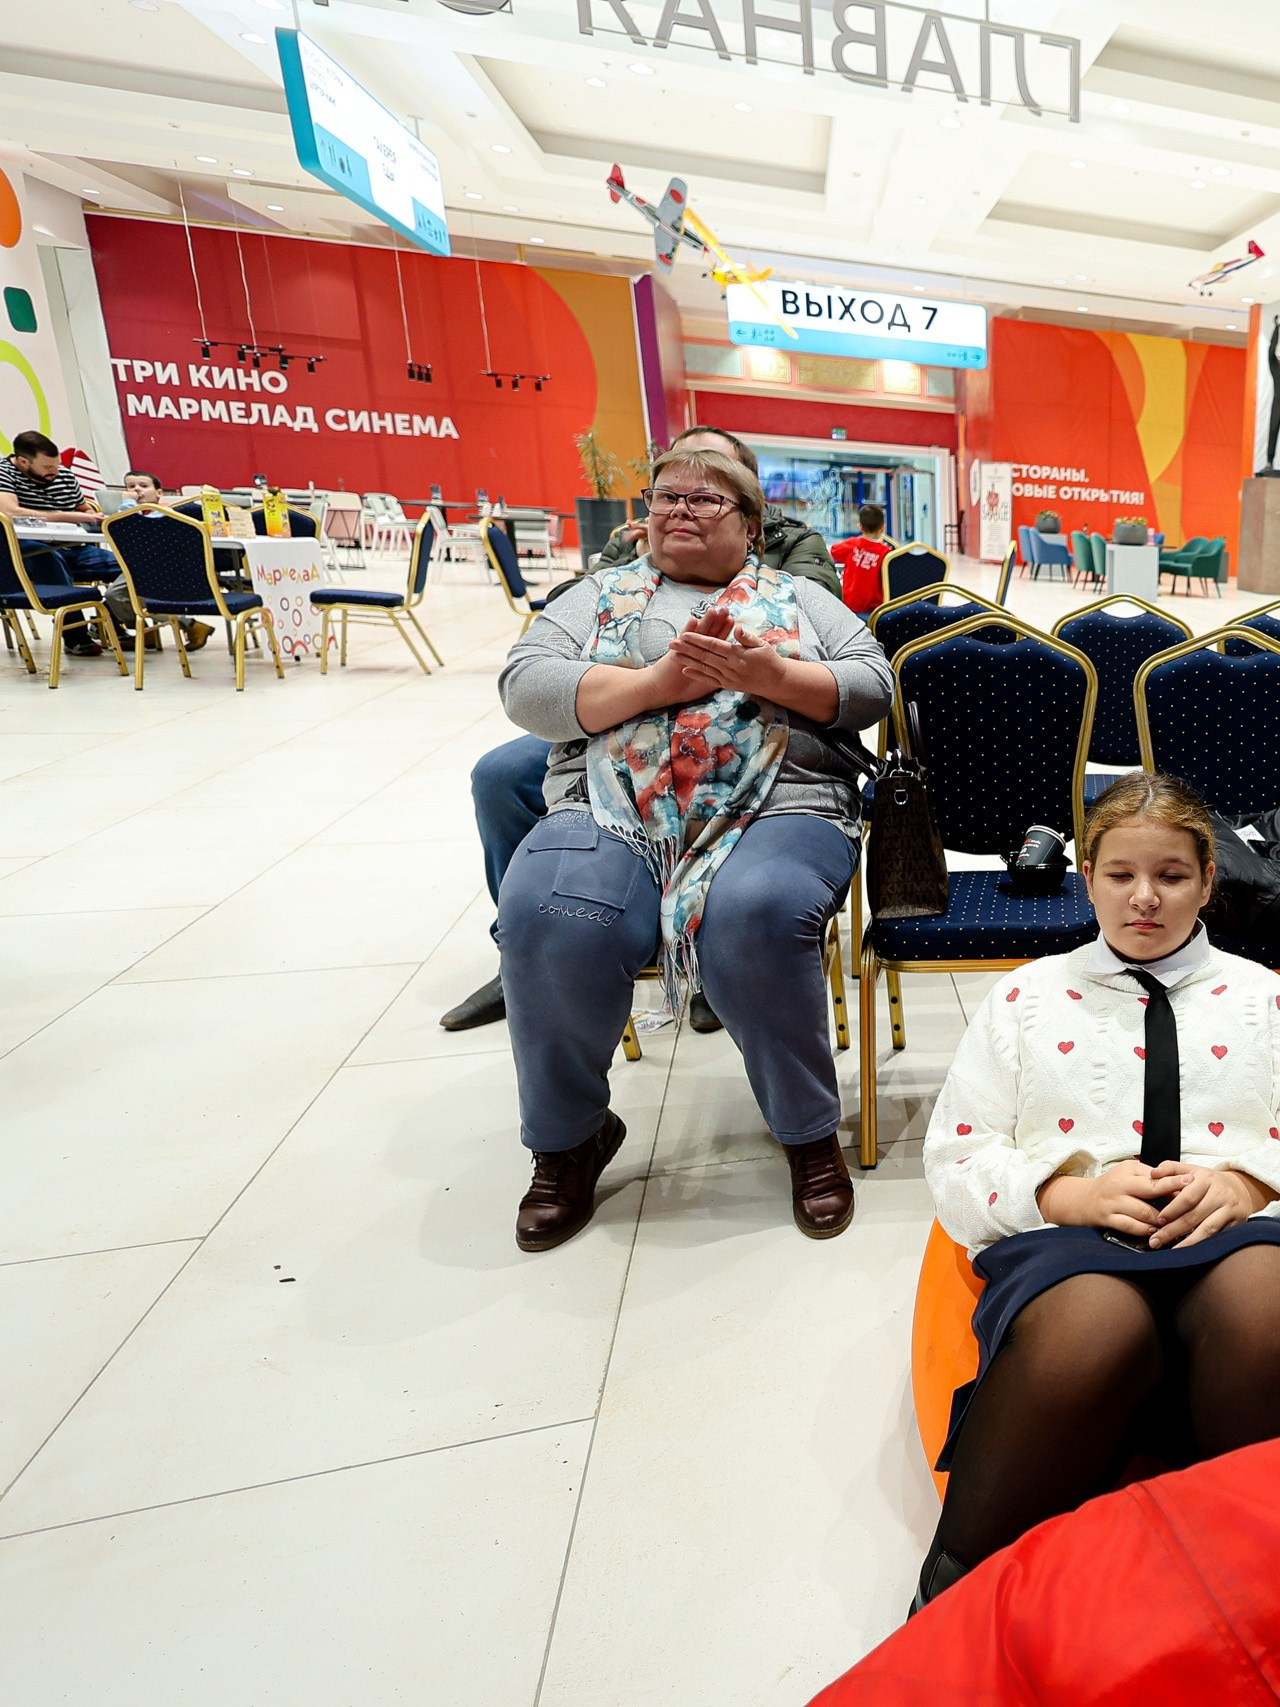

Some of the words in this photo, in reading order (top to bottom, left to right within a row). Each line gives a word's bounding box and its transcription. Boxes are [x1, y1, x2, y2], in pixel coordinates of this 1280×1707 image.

[781, 289, 911, 333] ВЫХОД
[921, 306, 938, 331] 7
[111, 357, 181, 386] ТРИ
[189, 363, 289, 395] КИНО
[126, 393, 319, 434] МАРМЕЛАД
[324, 407, 460, 440] СИНЕМА
[1011, 463, 1089, 483] СТОРАНЫ.
[1012, 482, 1057, 499] ОВЫЕ
